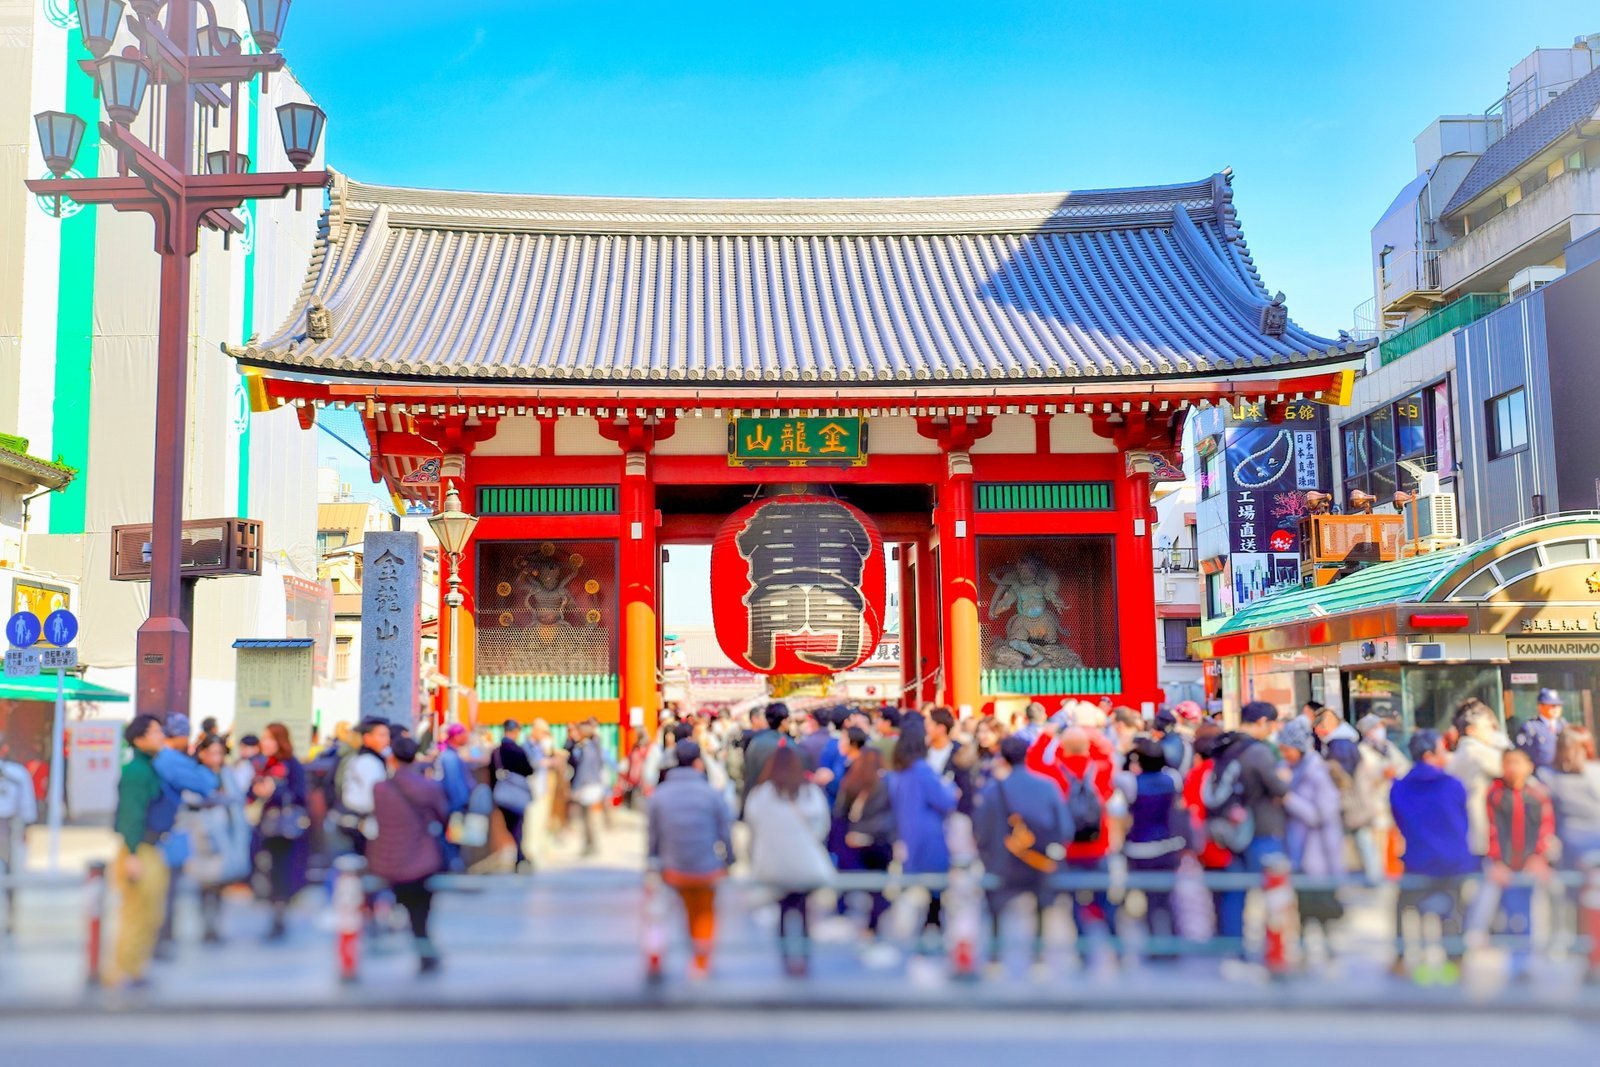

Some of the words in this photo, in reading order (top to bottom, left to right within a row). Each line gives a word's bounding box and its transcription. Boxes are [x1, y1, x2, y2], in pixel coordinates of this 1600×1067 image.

[1232, 402, 1315, 421] 山本石館
[1297, 434, 1307, 487] 日本真珠
[1237, 491, 1258, 553] 工場直送
[736, 502, 873, 670] 雷門
